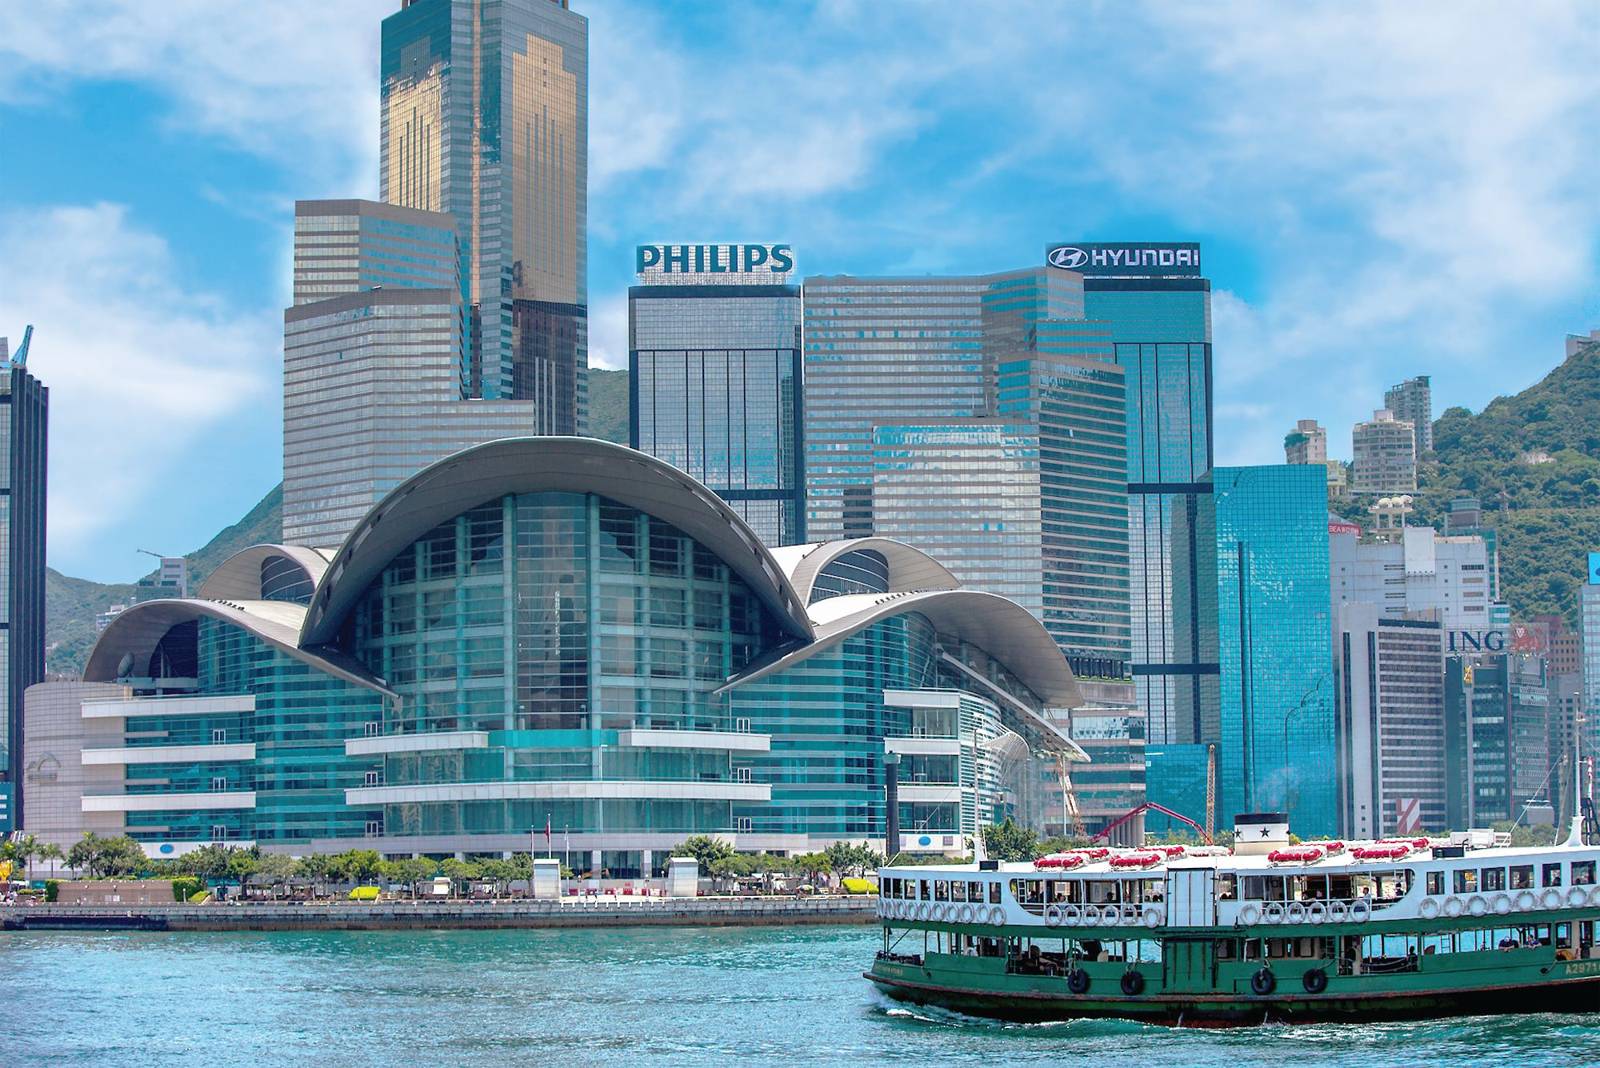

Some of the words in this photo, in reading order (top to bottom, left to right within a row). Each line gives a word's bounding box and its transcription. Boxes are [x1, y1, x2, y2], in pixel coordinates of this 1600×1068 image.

[636, 244, 793, 273] PHILIPS
[1091, 249, 1199, 266] HYUNDAI
[1448, 630, 1504, 651] ING
[1565, 961, 1600, 975] A2971
